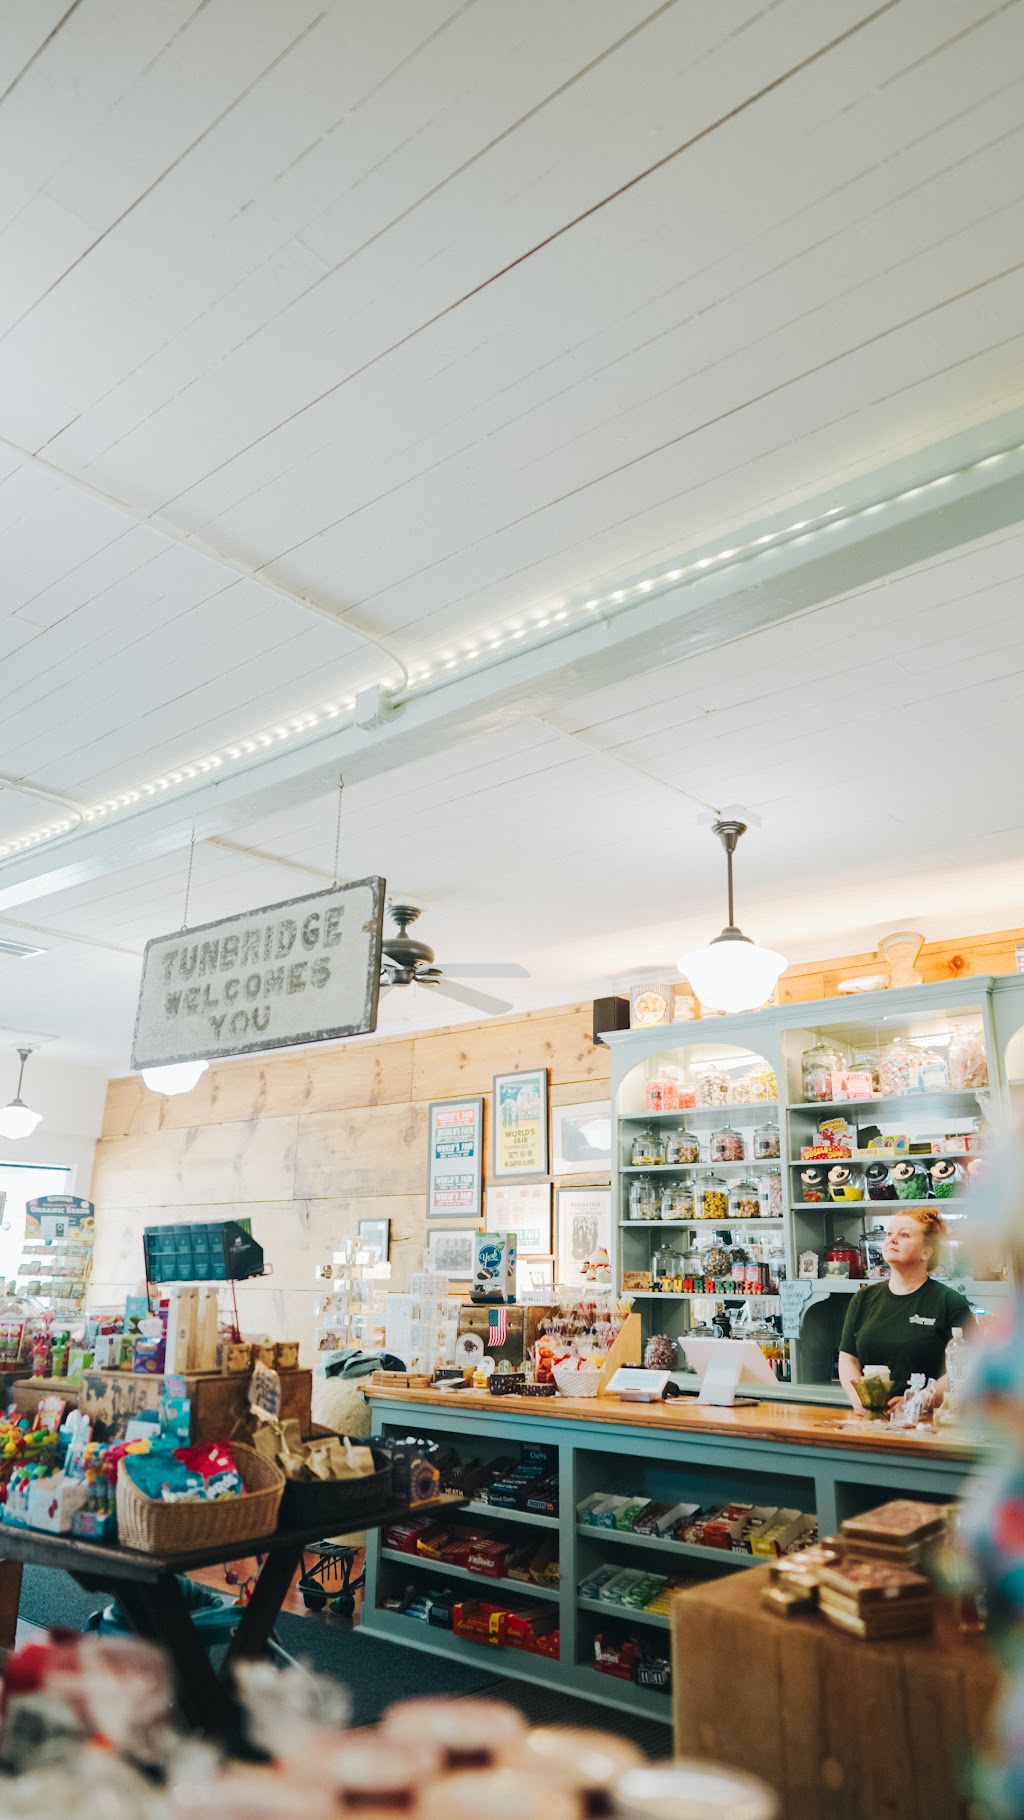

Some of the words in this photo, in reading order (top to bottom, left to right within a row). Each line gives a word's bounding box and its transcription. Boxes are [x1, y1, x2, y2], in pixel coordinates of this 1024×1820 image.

[161, 905, 346, 987] TUNBRIDGE
[164, 956, 332, 1021] WELCOMES
[209, 1004, 271, 1041] YOU
[462, 1110, 473, 1119] FAIR
[461, 1126, 474, 1136] FAIR
[505, 1129, 535, 1138] WORLD'S
[461, 1142, 473, 1151] FAIR
[460, 1174, 473, 1184] FAIR
[460, 1190, 473, 1200] FAIR
[479, 1249, 500, 1268] York
[661, 1278, 752, 1292] TUNBRIDGE
[444, 1488, 464, 1497] HEATH
